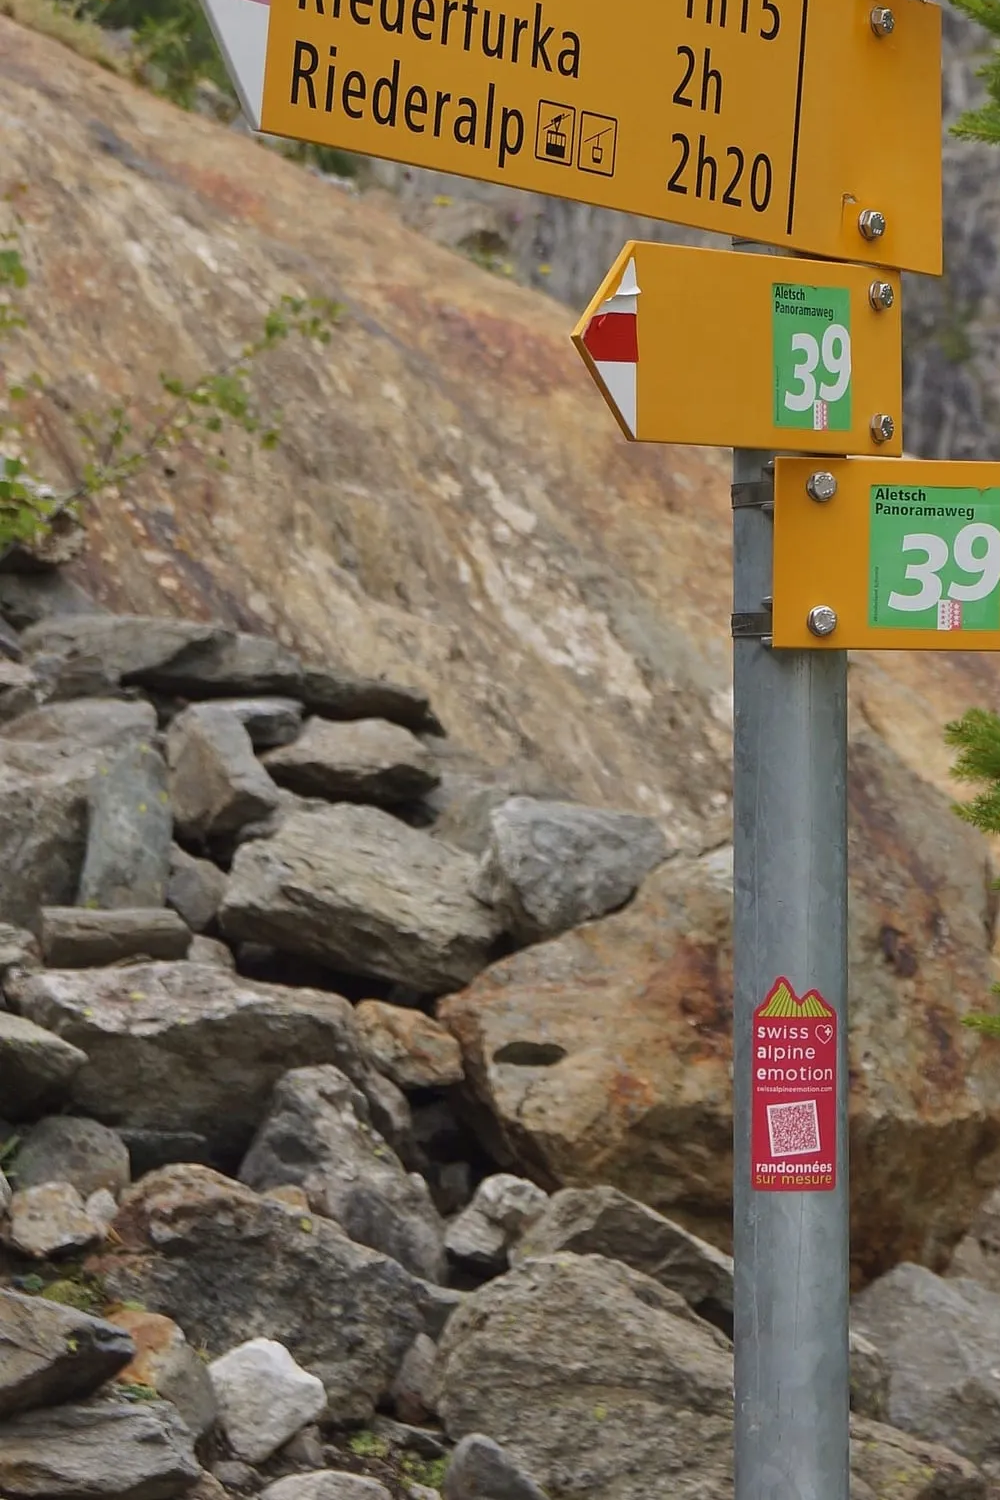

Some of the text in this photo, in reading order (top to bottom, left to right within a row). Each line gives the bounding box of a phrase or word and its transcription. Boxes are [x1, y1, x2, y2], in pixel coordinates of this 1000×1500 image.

[672, 45, 722, 115] 2h
[290, 39, 773, 213] Riederalp 2h20
[774, 286, 806, 301] Aletsch
[774, 301, 834, 321] Panoramaweg
[784, 323, 852, 412] 39
[875, 488, 927, 502] Aletsch
[875, 502, 975, 521] Panoramaweg
[756, 1025, 810, 1040] swiss
[756, 1044, 816, 1063] alpine
[756, 1066, 833, 1081] emotion
[755, 1160, 833, 1174] randonnées
[755, 1174, 833, 1185] sur mesure
